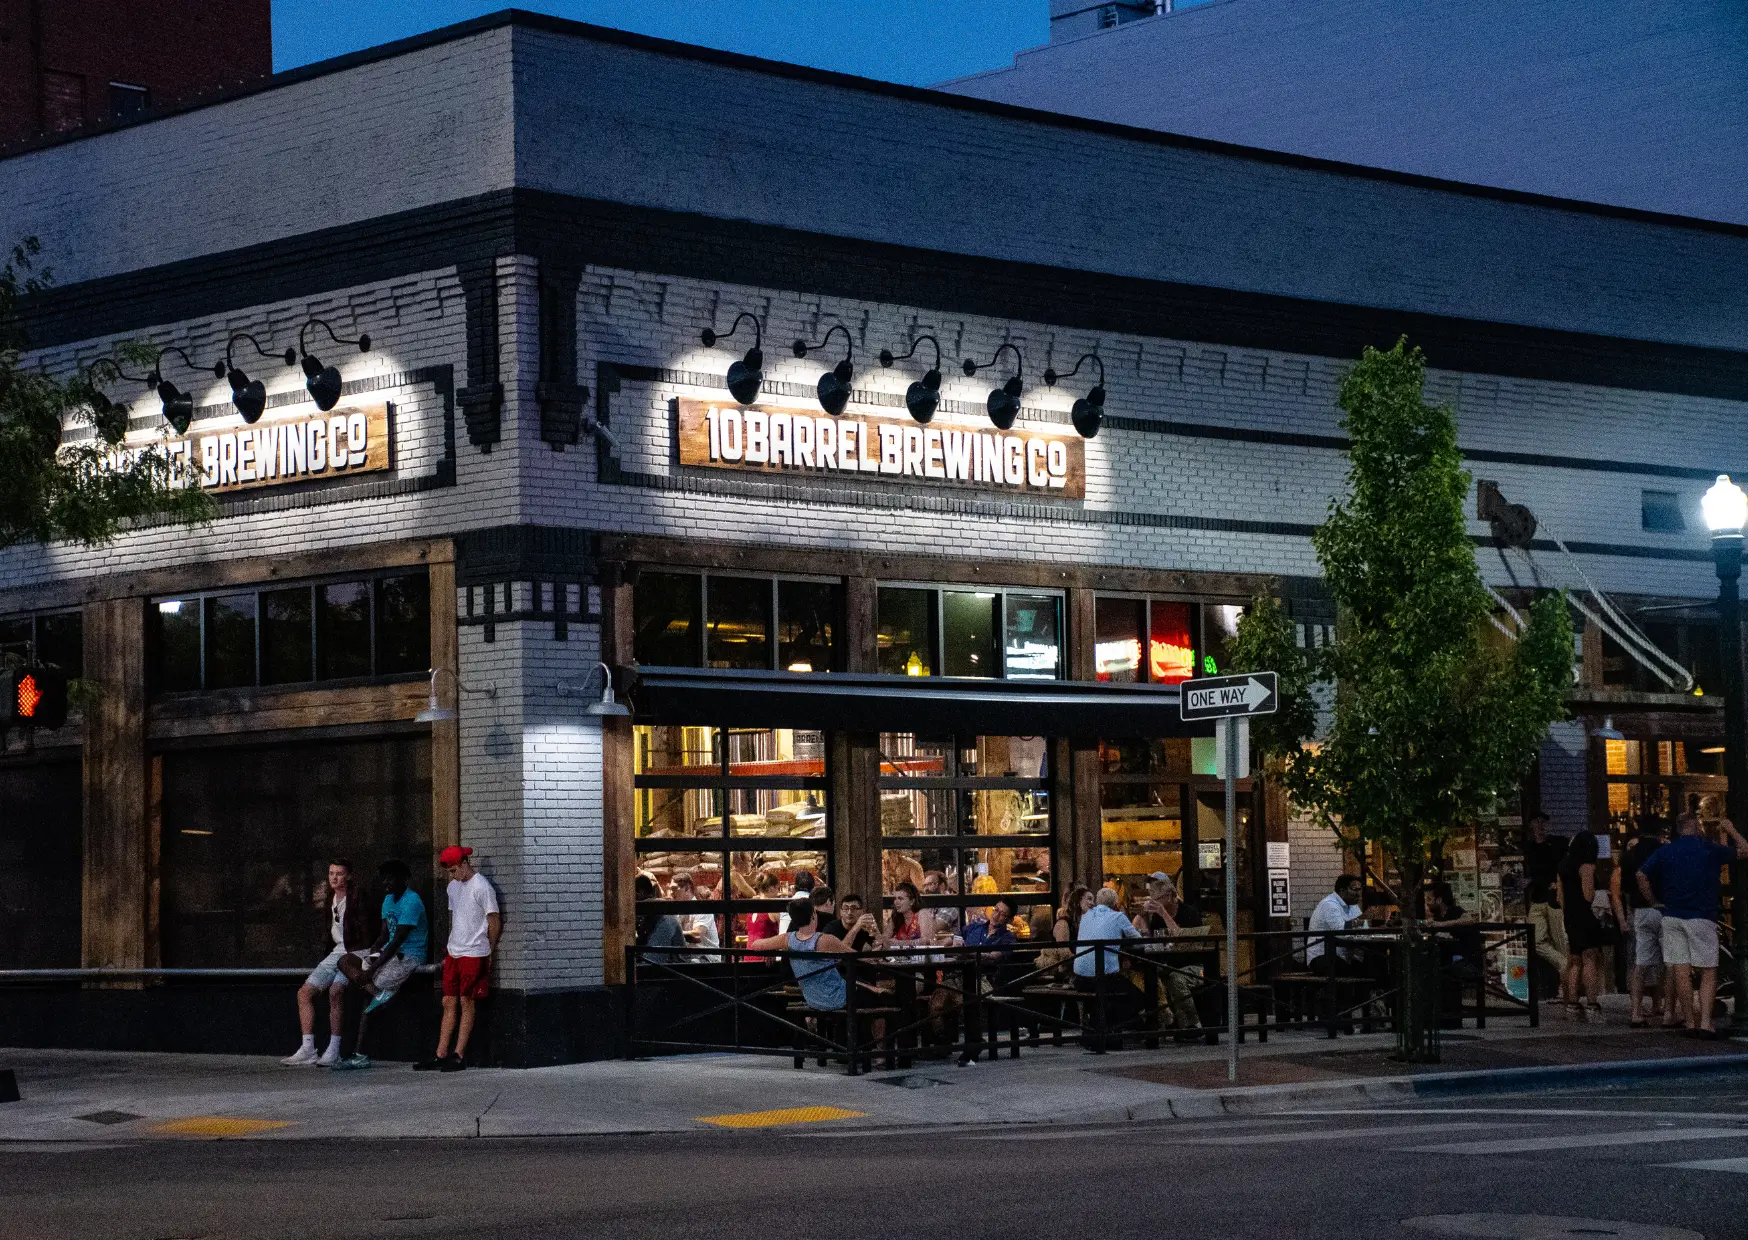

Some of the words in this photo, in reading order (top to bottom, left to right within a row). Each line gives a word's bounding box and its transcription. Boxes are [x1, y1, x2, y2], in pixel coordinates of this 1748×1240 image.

[200, 419, 326, 487] BREWING
[706, 407, 742, 461] 10
[744, 410, 881, 473] BARREL
[879, 423, 1024, 485] BREWING
[1190, 691, 1216, 707] ONE
[1220, 687, 1247, 704] WAY
